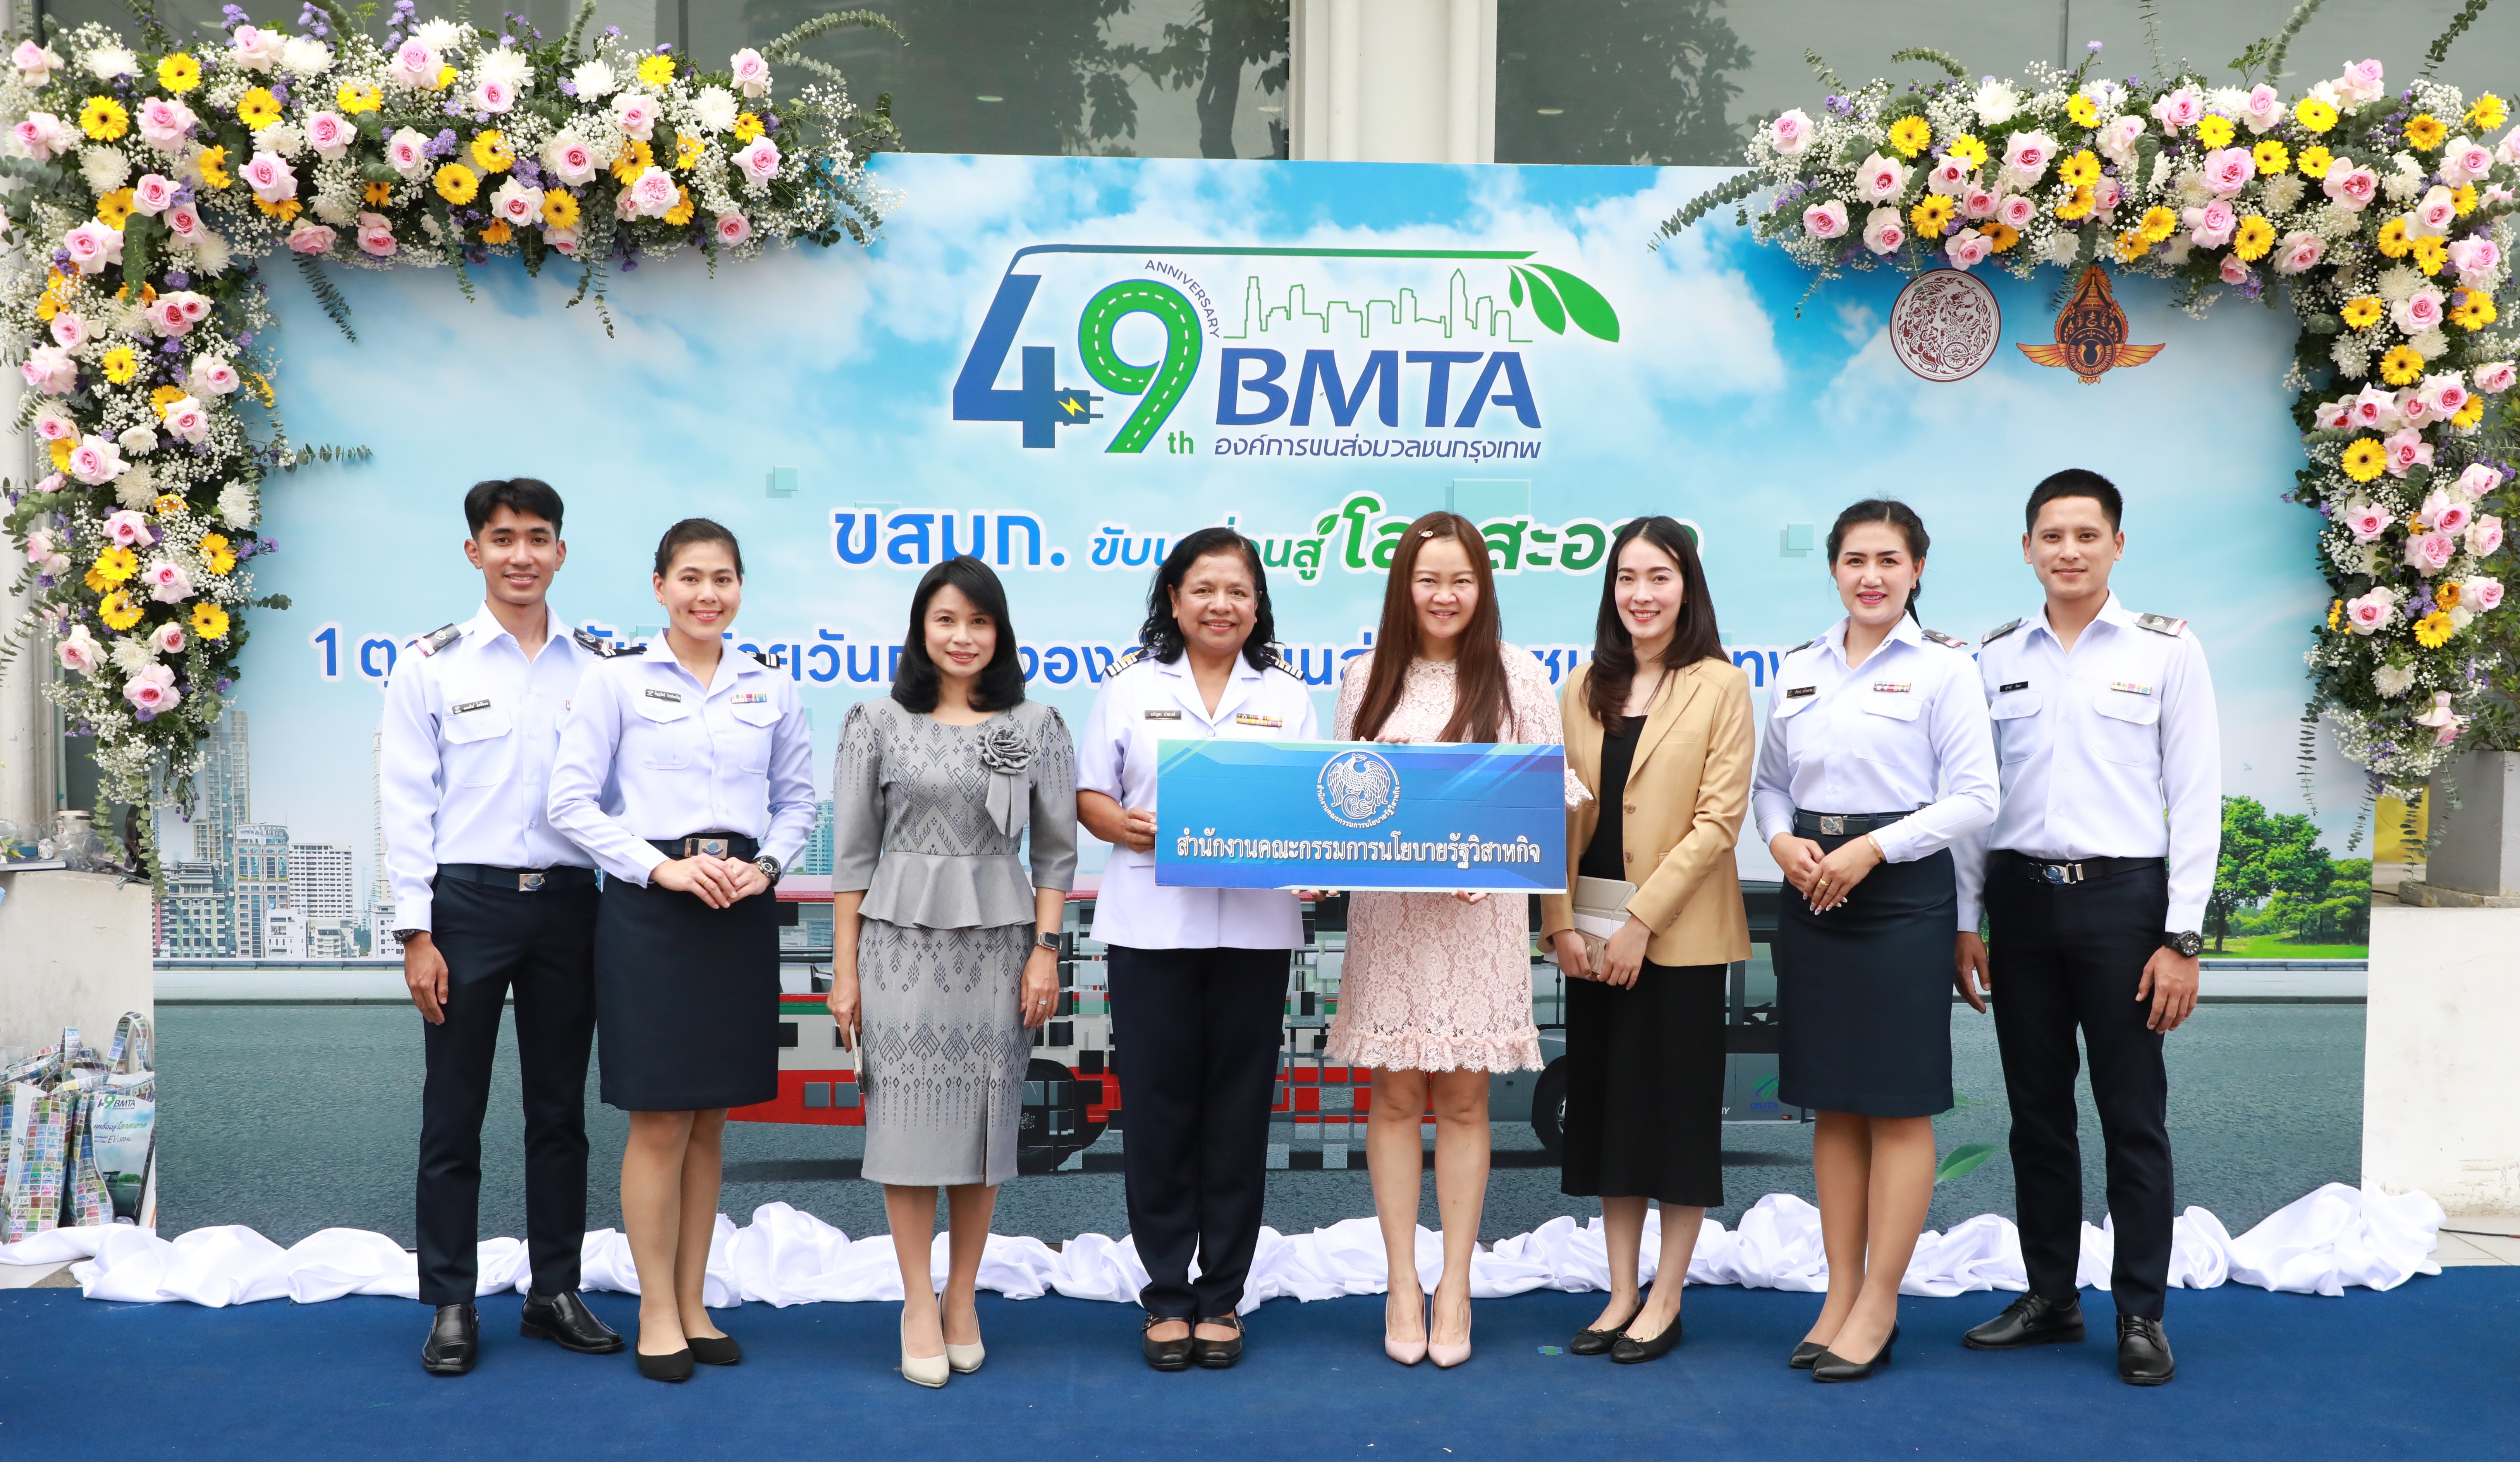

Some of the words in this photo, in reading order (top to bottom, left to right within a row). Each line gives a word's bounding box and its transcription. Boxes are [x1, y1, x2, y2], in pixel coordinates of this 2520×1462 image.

[1145, 260, 1220, 338] ANNIVERSARY
[1216, 348, 1542, 429] BMTA
[1215, 434, 1542, 463] องค์การขนส่งมวลชนกรุงเทพ
[835, 514, 1065, 565] ขสมก.
[1176, 826, 1541, 869] สำนักงานคณะกรรมการนโยบายรัฐวิสาหกิจ
